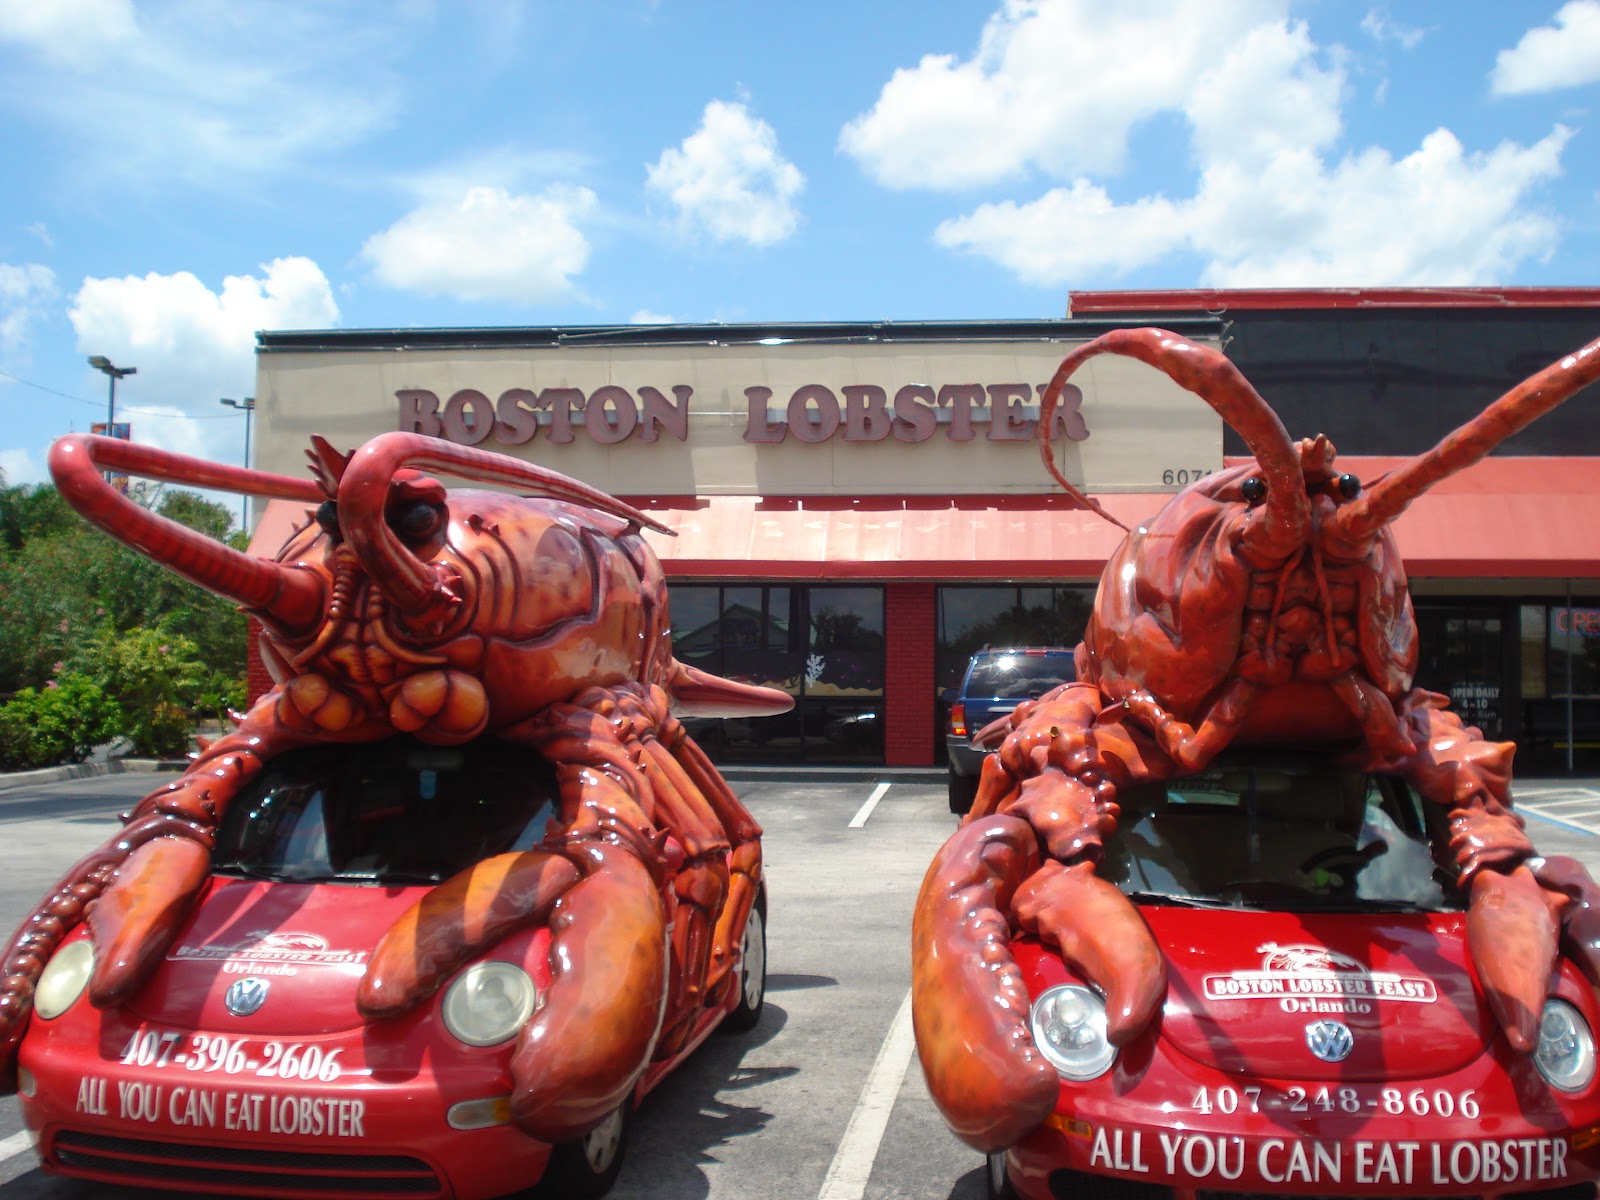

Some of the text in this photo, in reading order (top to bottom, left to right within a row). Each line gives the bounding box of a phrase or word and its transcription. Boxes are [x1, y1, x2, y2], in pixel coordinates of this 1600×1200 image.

[395, 383, 1090, 446] BOSTON LOBSTER
[1475, 687, 1500, 698] DAILY
[222, 962, 298, 977] Orlando
[240, 950, 312, 961] LOBSTER
[315, 952, 366, 963] FEAST
[1214, 979, 1427, 998] BOSTON LOBSTER FEAST
[1280, 998, 1371, 1014] Orlando
[119, 1029, 344, 1082] 407-396-2606
[75, 1077, 365, 1138] ALL YOU CAN EAT LOBSTER
[1192, 1086, 1480, 1120] 407-248-8606
[1090, 1128, 1568, 1185] ALL YOU CAN EAT LOBSTER
